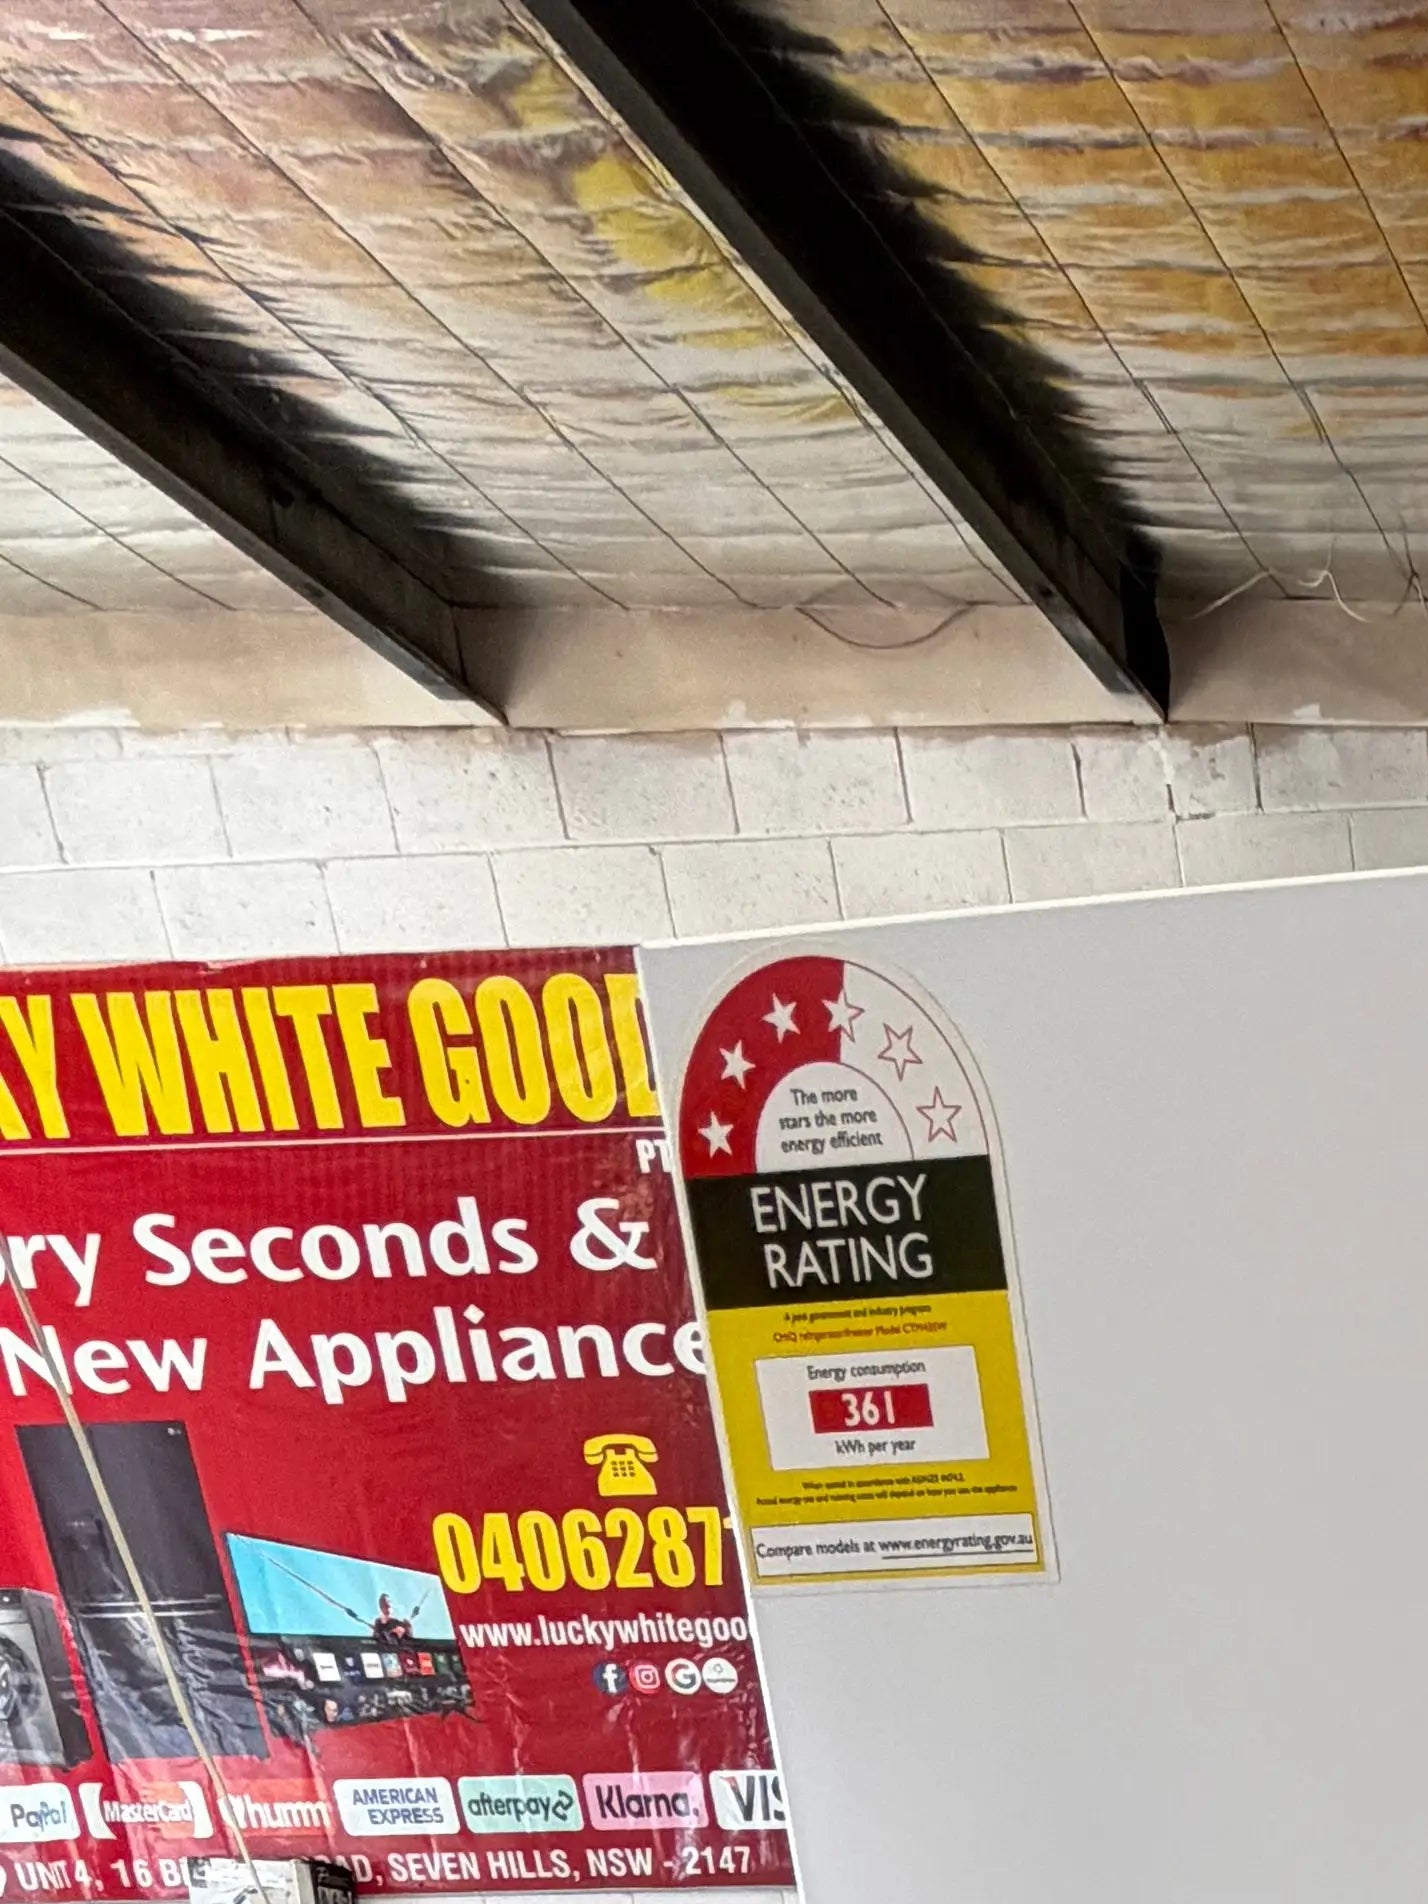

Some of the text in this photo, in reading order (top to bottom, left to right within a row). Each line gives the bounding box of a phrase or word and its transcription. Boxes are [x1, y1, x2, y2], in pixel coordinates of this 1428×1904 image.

[70, 982, 406, 1136] WHITE
[790, 1087, 858, 1106] The more
[779, 1109, 878, 1130] stars the more
[780, 1129, 884, 1155] energy efficient
[750, 1173, 928, 1236] ENERGY
[0, 1196, 657, 1307] ry Seconds &
[763, 1232, 934, 1290] RATING
[0, 1325, 207, 1396] New
[806, 1359, 926, 1383] Energy consumption
[840, 1389, 897, 1429] 361
[835, 1438, 917, 1457] kWh per year
[432, 1505, 732, 1594] 0406287
[756, 1532, 1034, 1562] Compare models at www.energyrating.gov.au
[459, 1611, 752, 1650] www.luckywhitegoo
[353, 1786, 440, 1806] AMERICAN
[468, 1791, 550, 1823] afterpay
[11, 1800, 68, 1830] PayPal
[102, 1799, 194, 1824] MasterCard
[367, 1807, 445, 1825] EXPRESS
[13, 1859, 73, 1892] UNIT
[74, 1857, 104, 1892] 4,
[110, 1857, 153, 1889] 16
[387, 1852, 481, 1883] SEVEN
[486, 1848, 581, 1883] HILLS,
[586, 1847, 653, 1878] NSW
[681, 1845, 752, 1876] 2147
